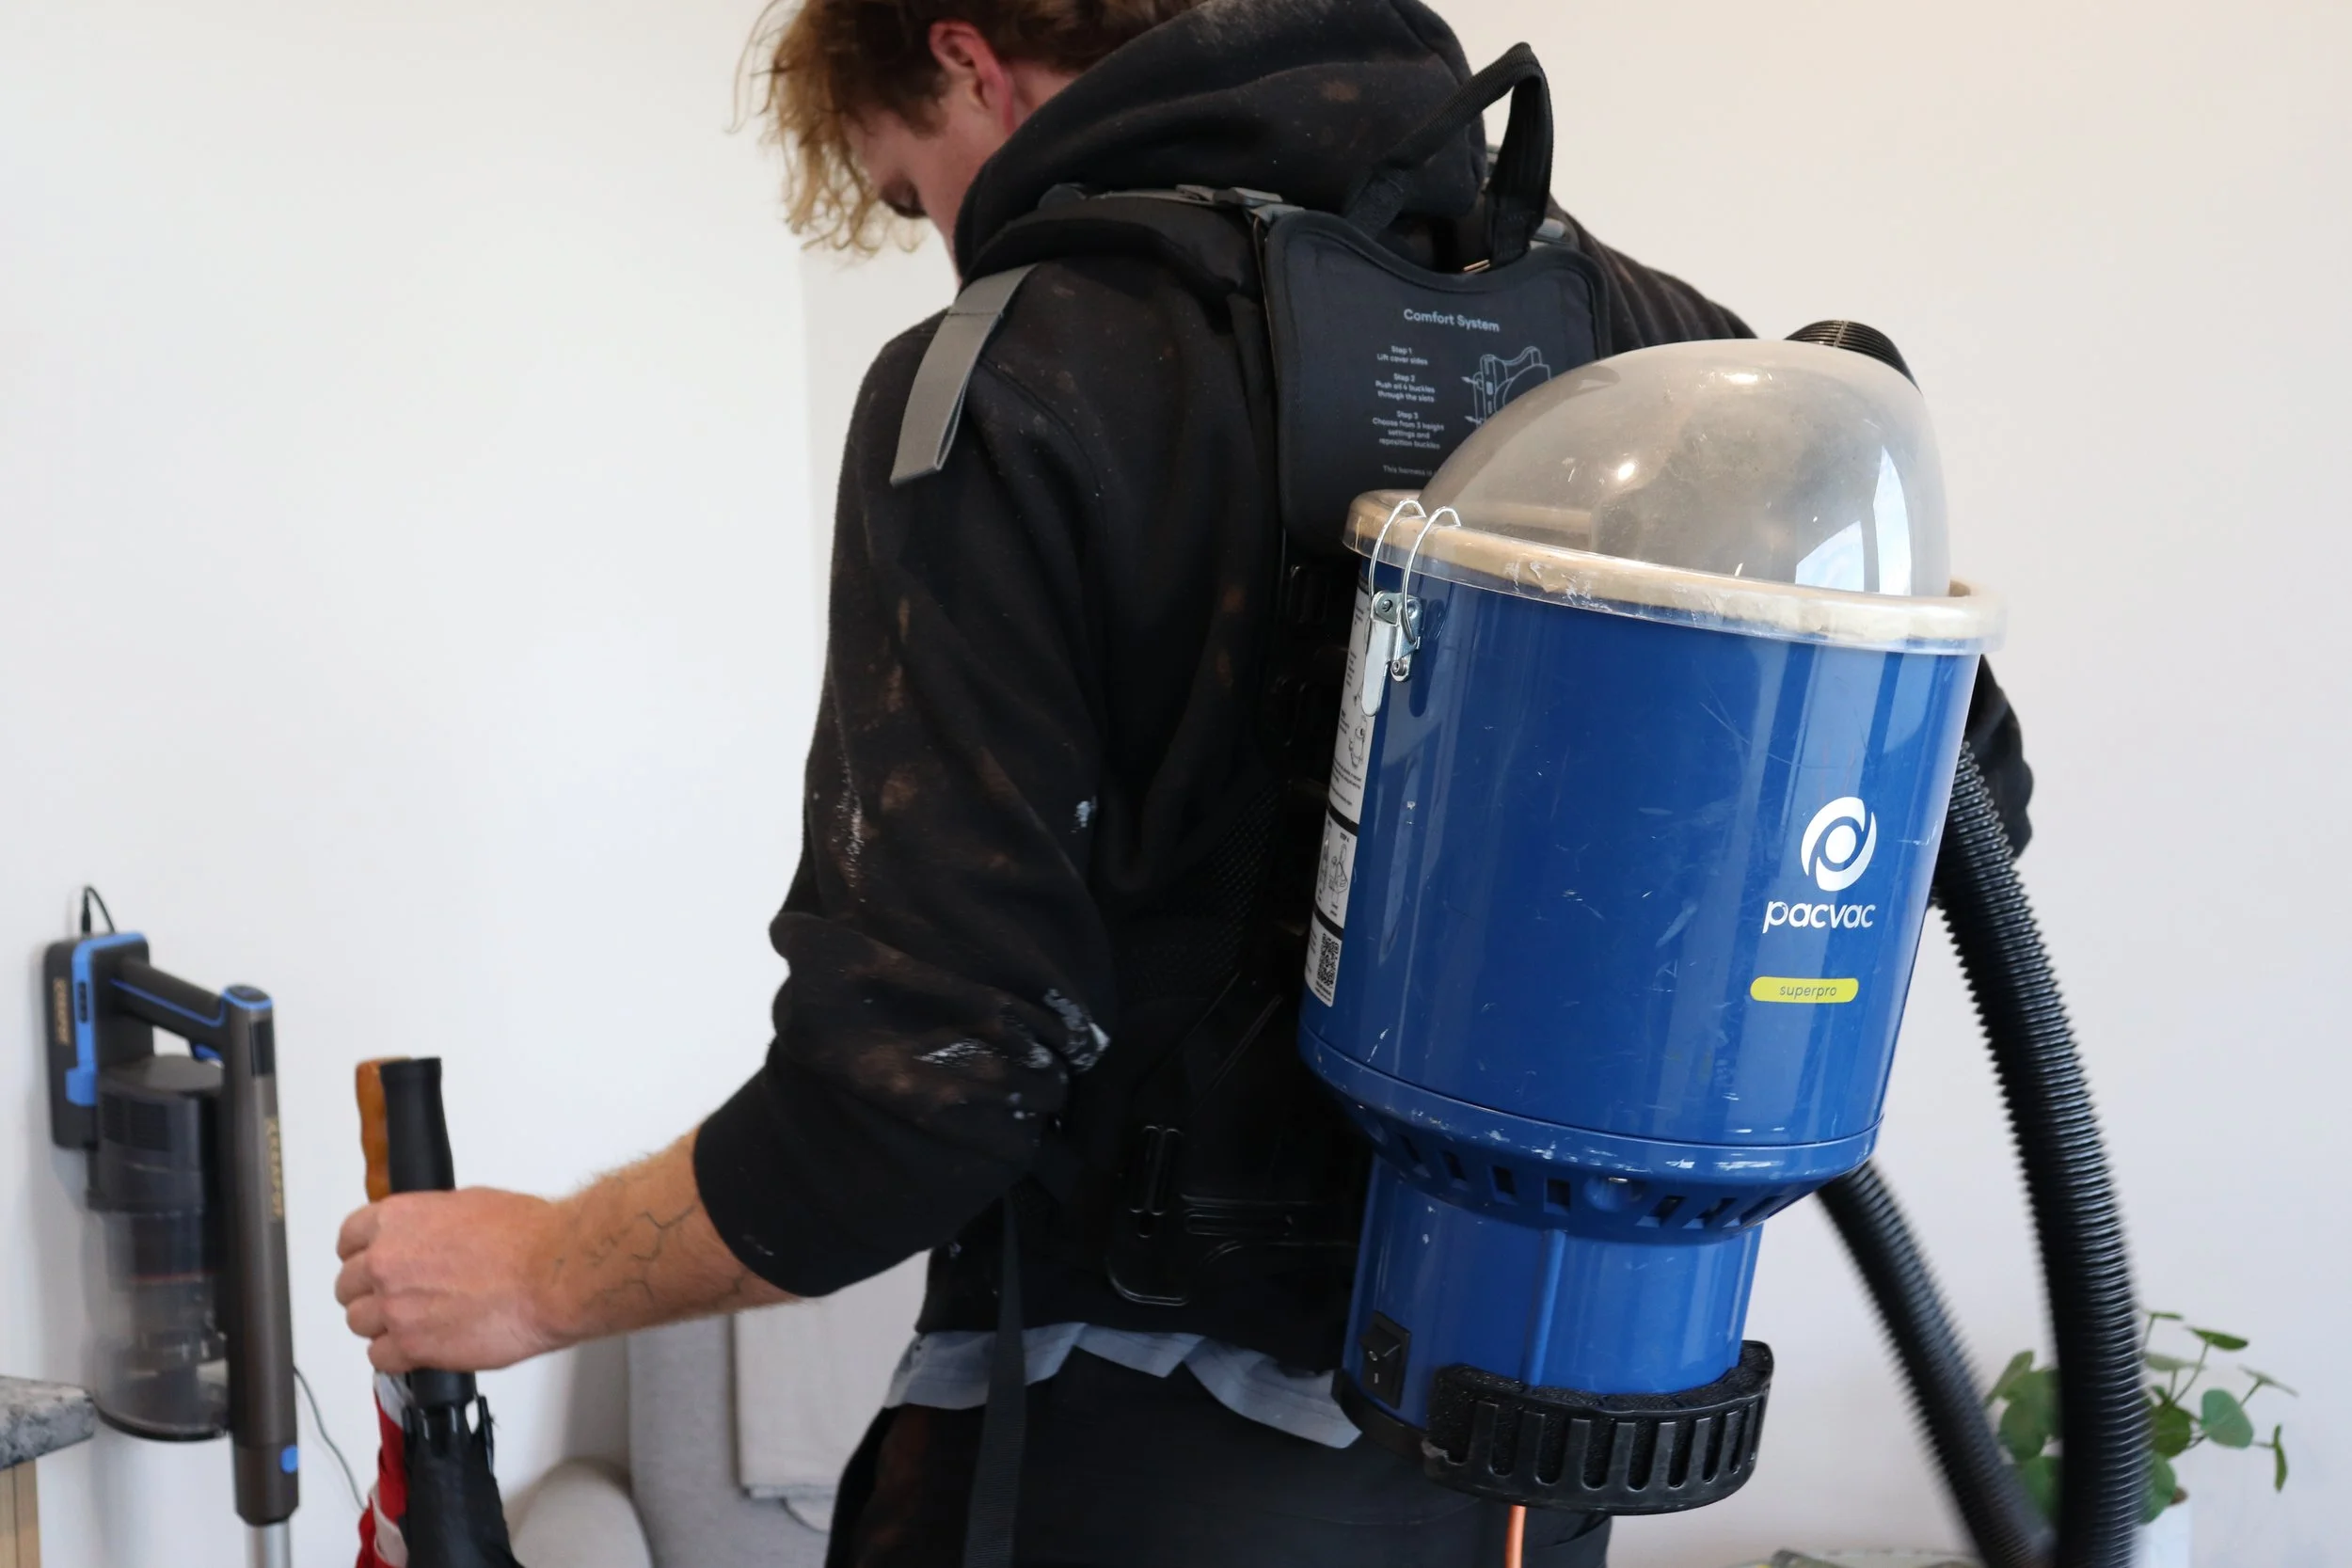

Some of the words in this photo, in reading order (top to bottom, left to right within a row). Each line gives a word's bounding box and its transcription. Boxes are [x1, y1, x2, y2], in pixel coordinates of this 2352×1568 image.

[1404, 309, 1454, 325] Comfort
[1457, 314, 1501, 333] System
[1391, 345, 1407, 355] Step
[1410, 356, 1428, 366] sides
[1393, 372, 1409, 382] Step
[1375, 380, 1392, 388] Push
[1408, 384, 1436, 394] buckles
[1377, 390, 1405, 401] through
[1406, 392, 1417, 401] the
[1418, 393, 1435, 403] slots
[1396, 410, 1412, 420] Step
[1372, 417, 1398, 427] Choose
[1399, 420, 1415, 428] from
[1422, 422, 1445, 433] height
[1388, 430, 1415, 439] settings
[1378, 437, 1413, 448] reposition
[1414, 440, 1440, 450] buckles
[1382, 465, 1397, 474] This
[1398, 466, 1425, 476] harness
[1762, 901, 1876, 934] pacvac
[1779, 984, 1837, 998] superpro
